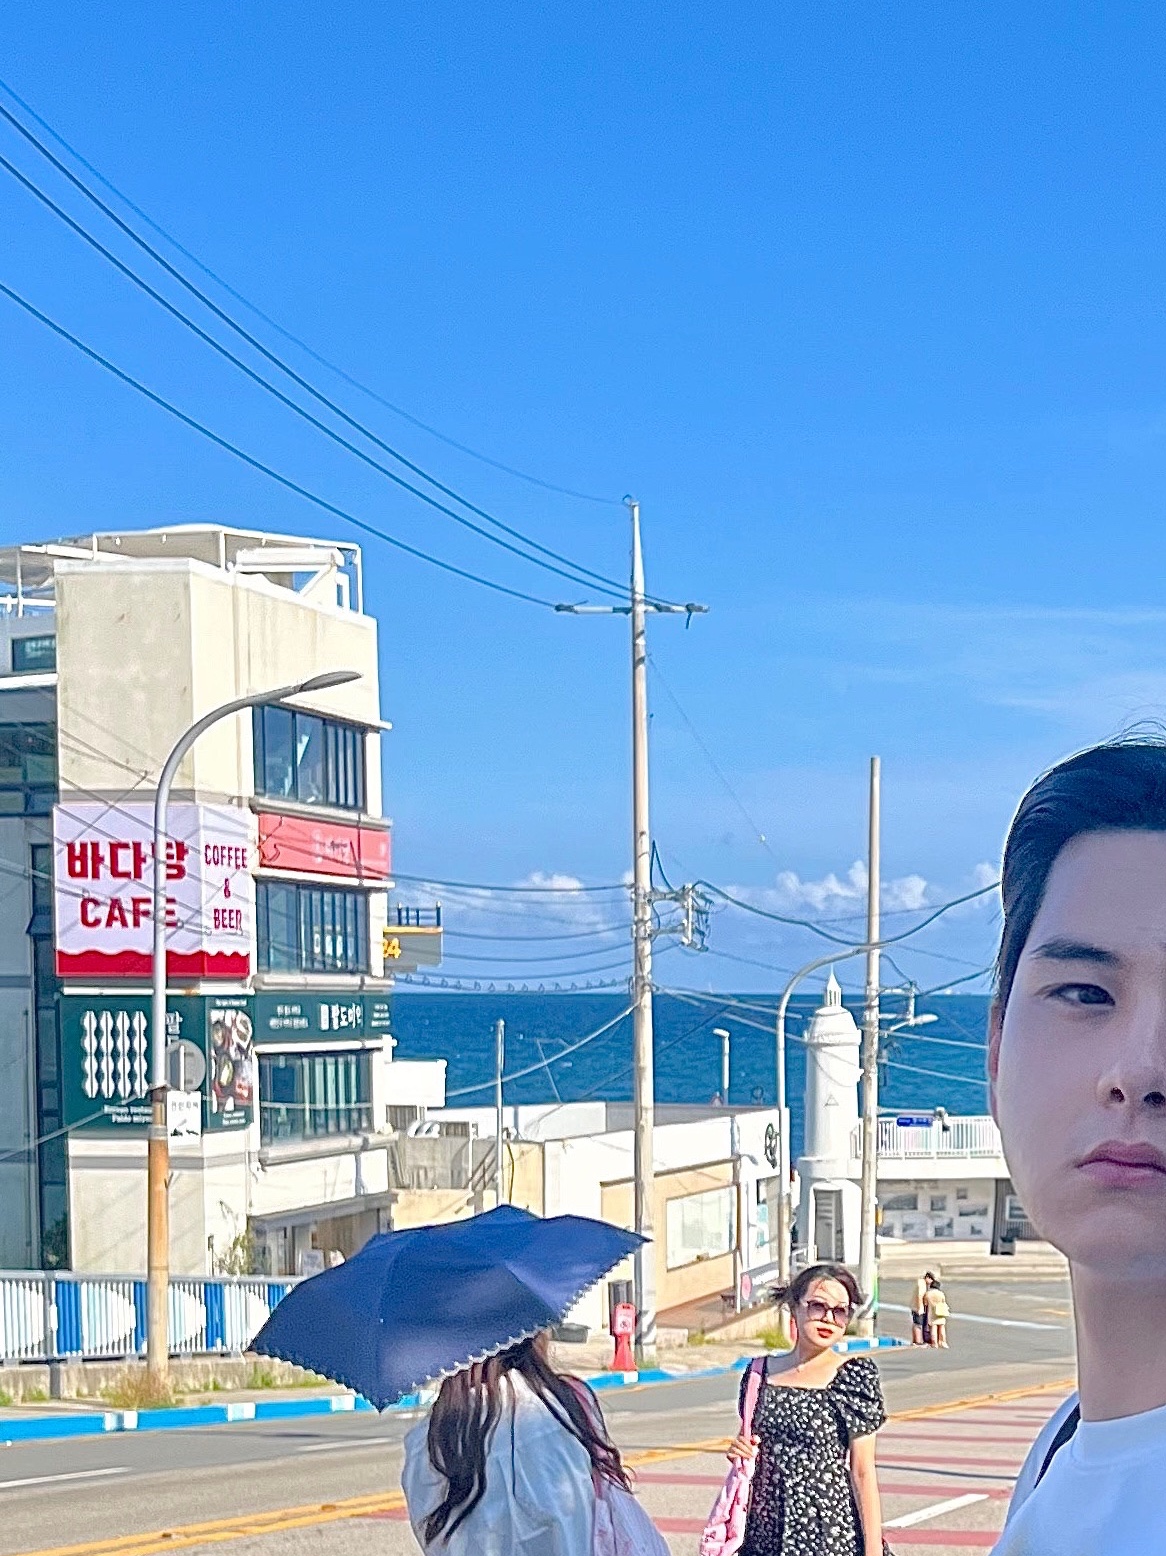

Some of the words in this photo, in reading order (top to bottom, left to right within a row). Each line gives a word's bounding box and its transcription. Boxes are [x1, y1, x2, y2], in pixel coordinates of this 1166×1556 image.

[204, 844, 248, 869] COFFEE
[223, 878, 231, 899] &
[80, 897, 177, 928] CAFE
[213, 908, 242, 930] BEER
